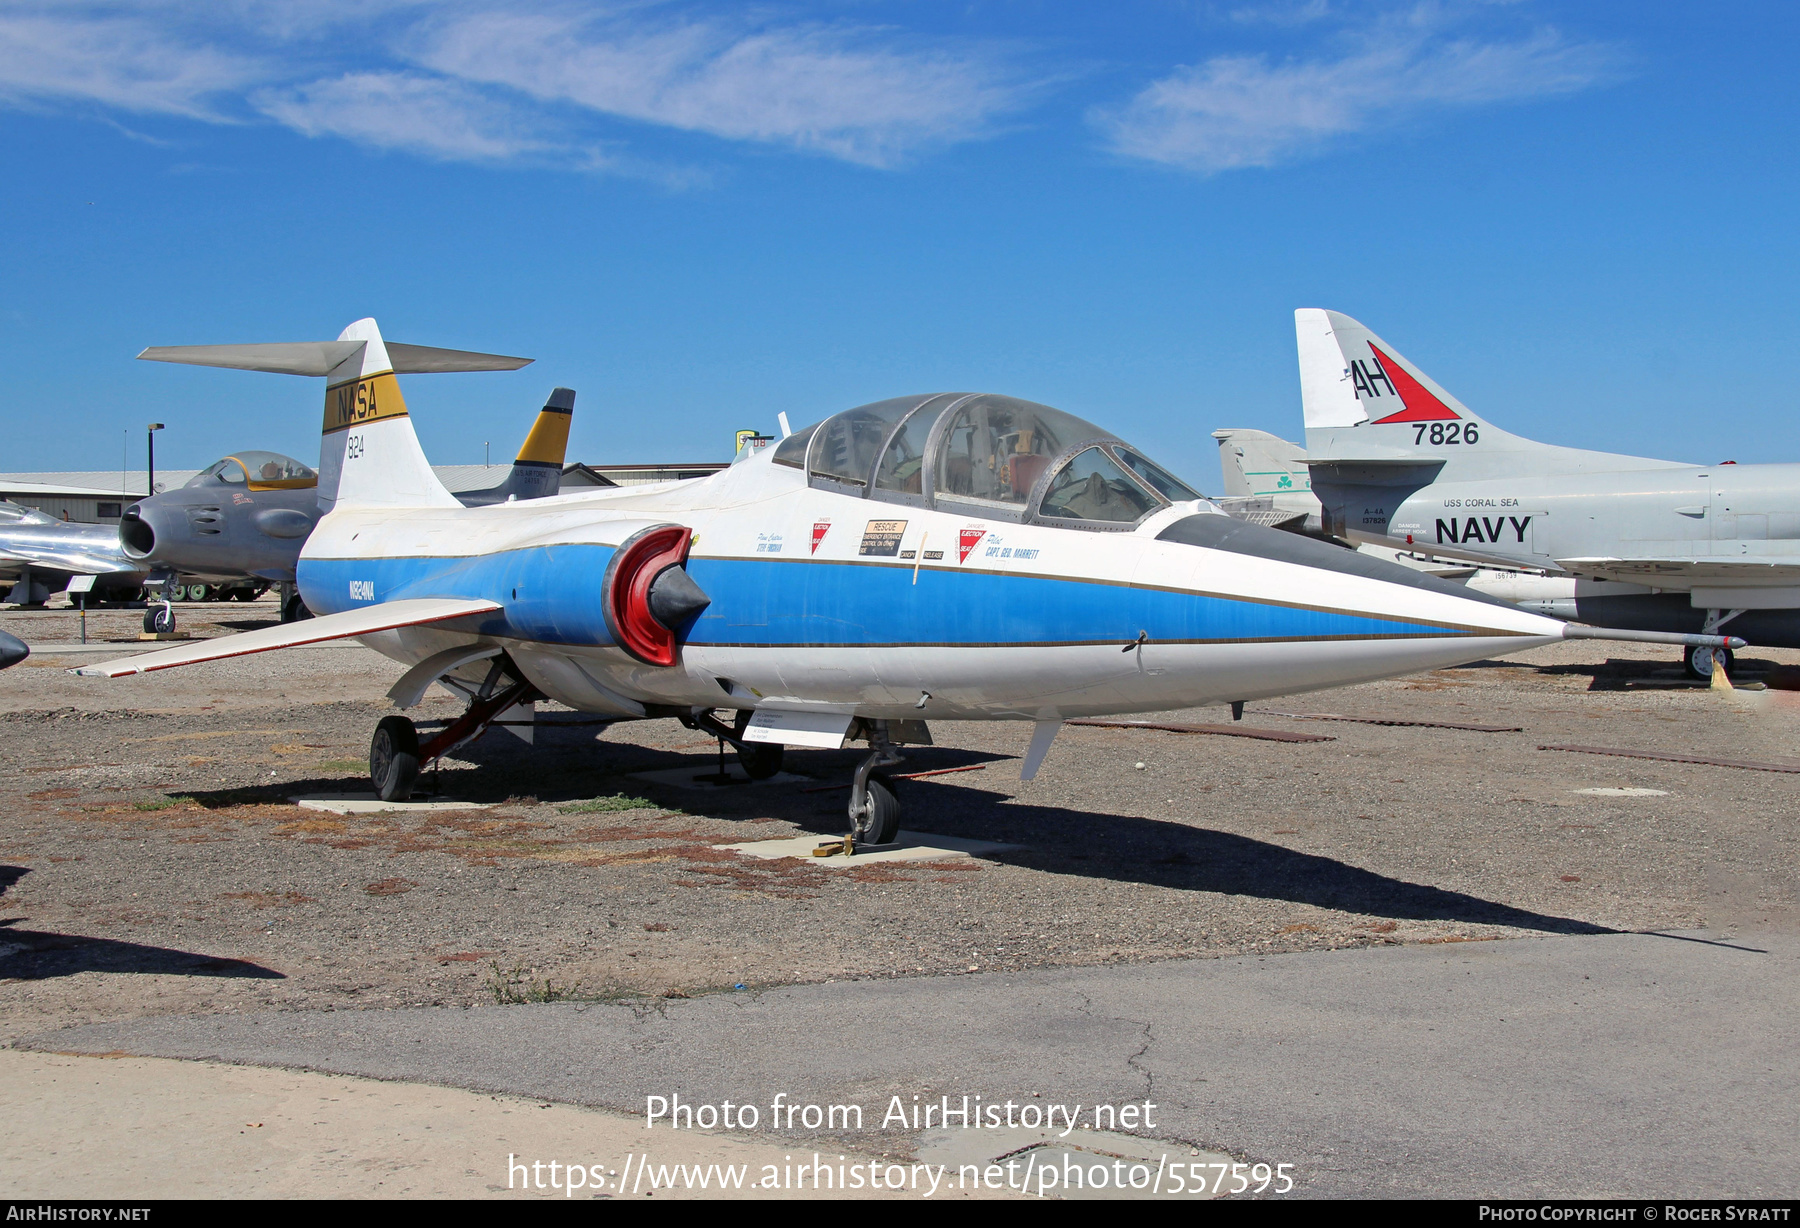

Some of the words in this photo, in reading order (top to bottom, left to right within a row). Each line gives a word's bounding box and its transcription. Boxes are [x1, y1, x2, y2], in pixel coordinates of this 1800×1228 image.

[1351, 357, 1395, 399] AH
[338, 381, 377, 424] NASA
[1412, 422, 1479, 445] 7826
[348, 434, 364, 459] 824
[1443, 499, 1461, 507] USS
[1465, 499, 1496, 507] CORAL
[1500, 498, 1519, 507] SEA
[873, 522, 898, 531] RESCUE
[1362, 517, 1387, 525] 137826
[1435, 515, 1532, 544] NAVY
[924, 551, 943, 559] RELEASE
[350, 580, 375, 601] N824NA
